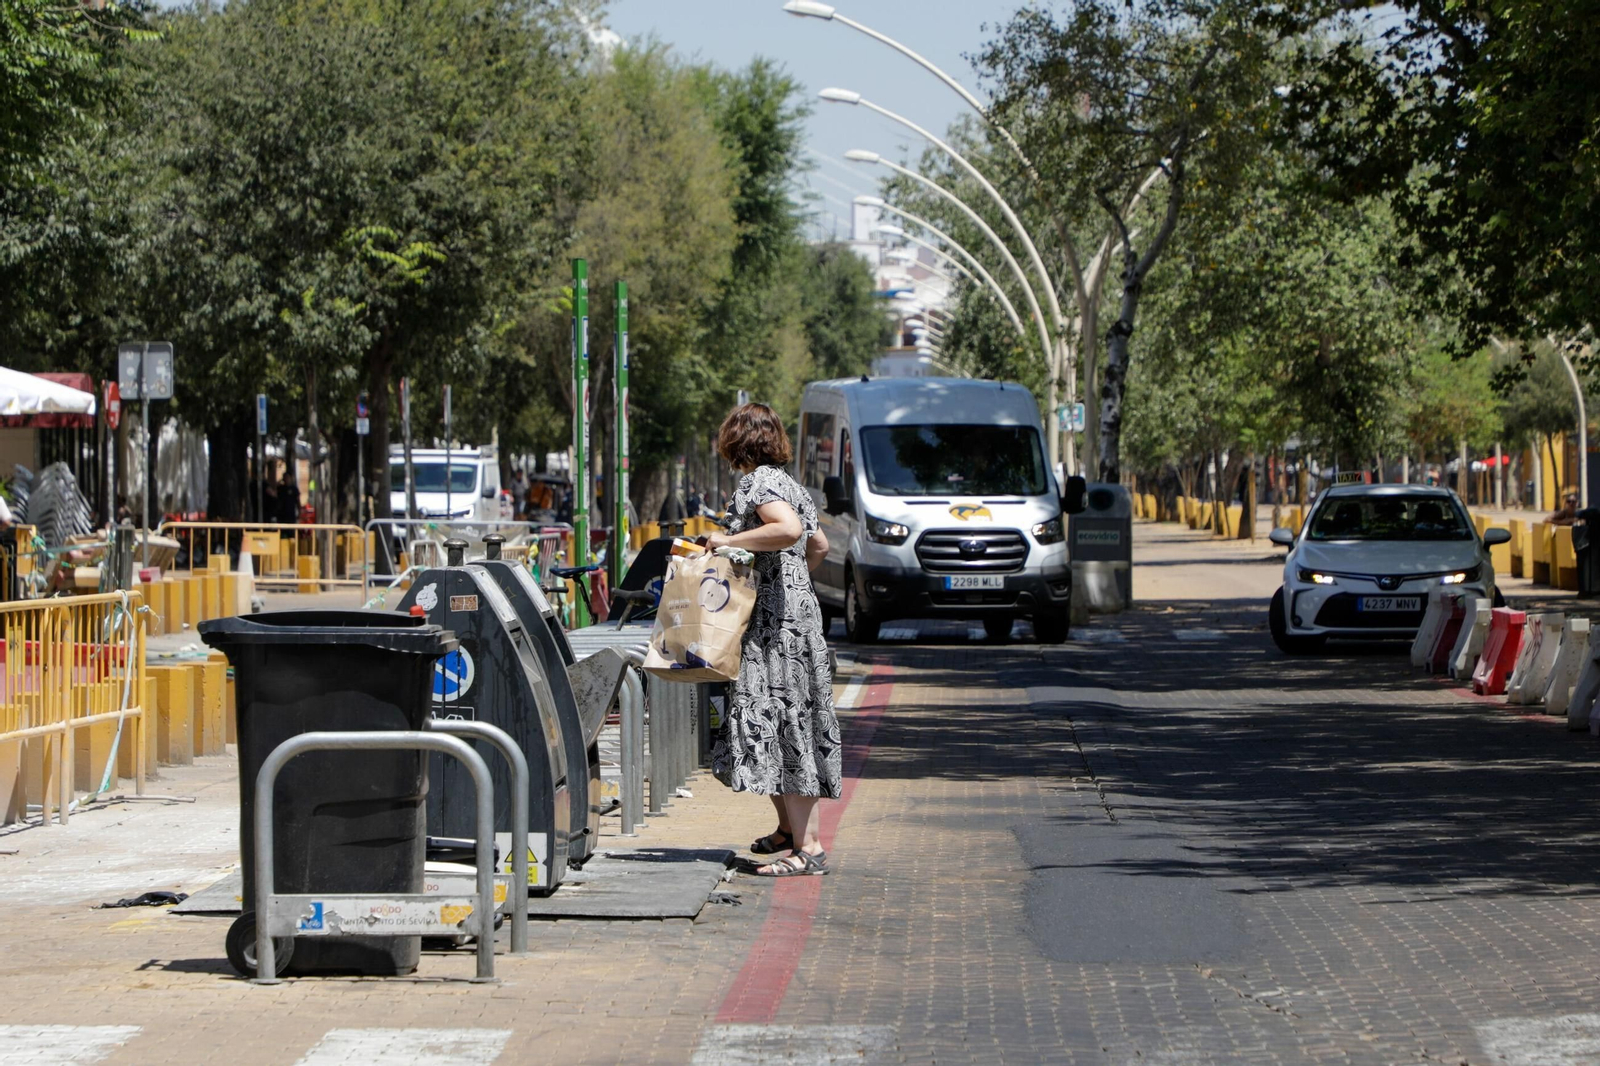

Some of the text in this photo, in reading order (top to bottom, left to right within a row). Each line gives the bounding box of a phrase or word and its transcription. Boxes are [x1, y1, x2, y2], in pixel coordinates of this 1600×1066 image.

[1338, 473, 1354, 482] TAXI
[1079, 531, 1119, 540] ecovidrio
[953, 577, 1001, 587] 2298 MLL
[1364, 598, 1417, 609] 4237 MNV
[396, 918, 406, 926] DE
